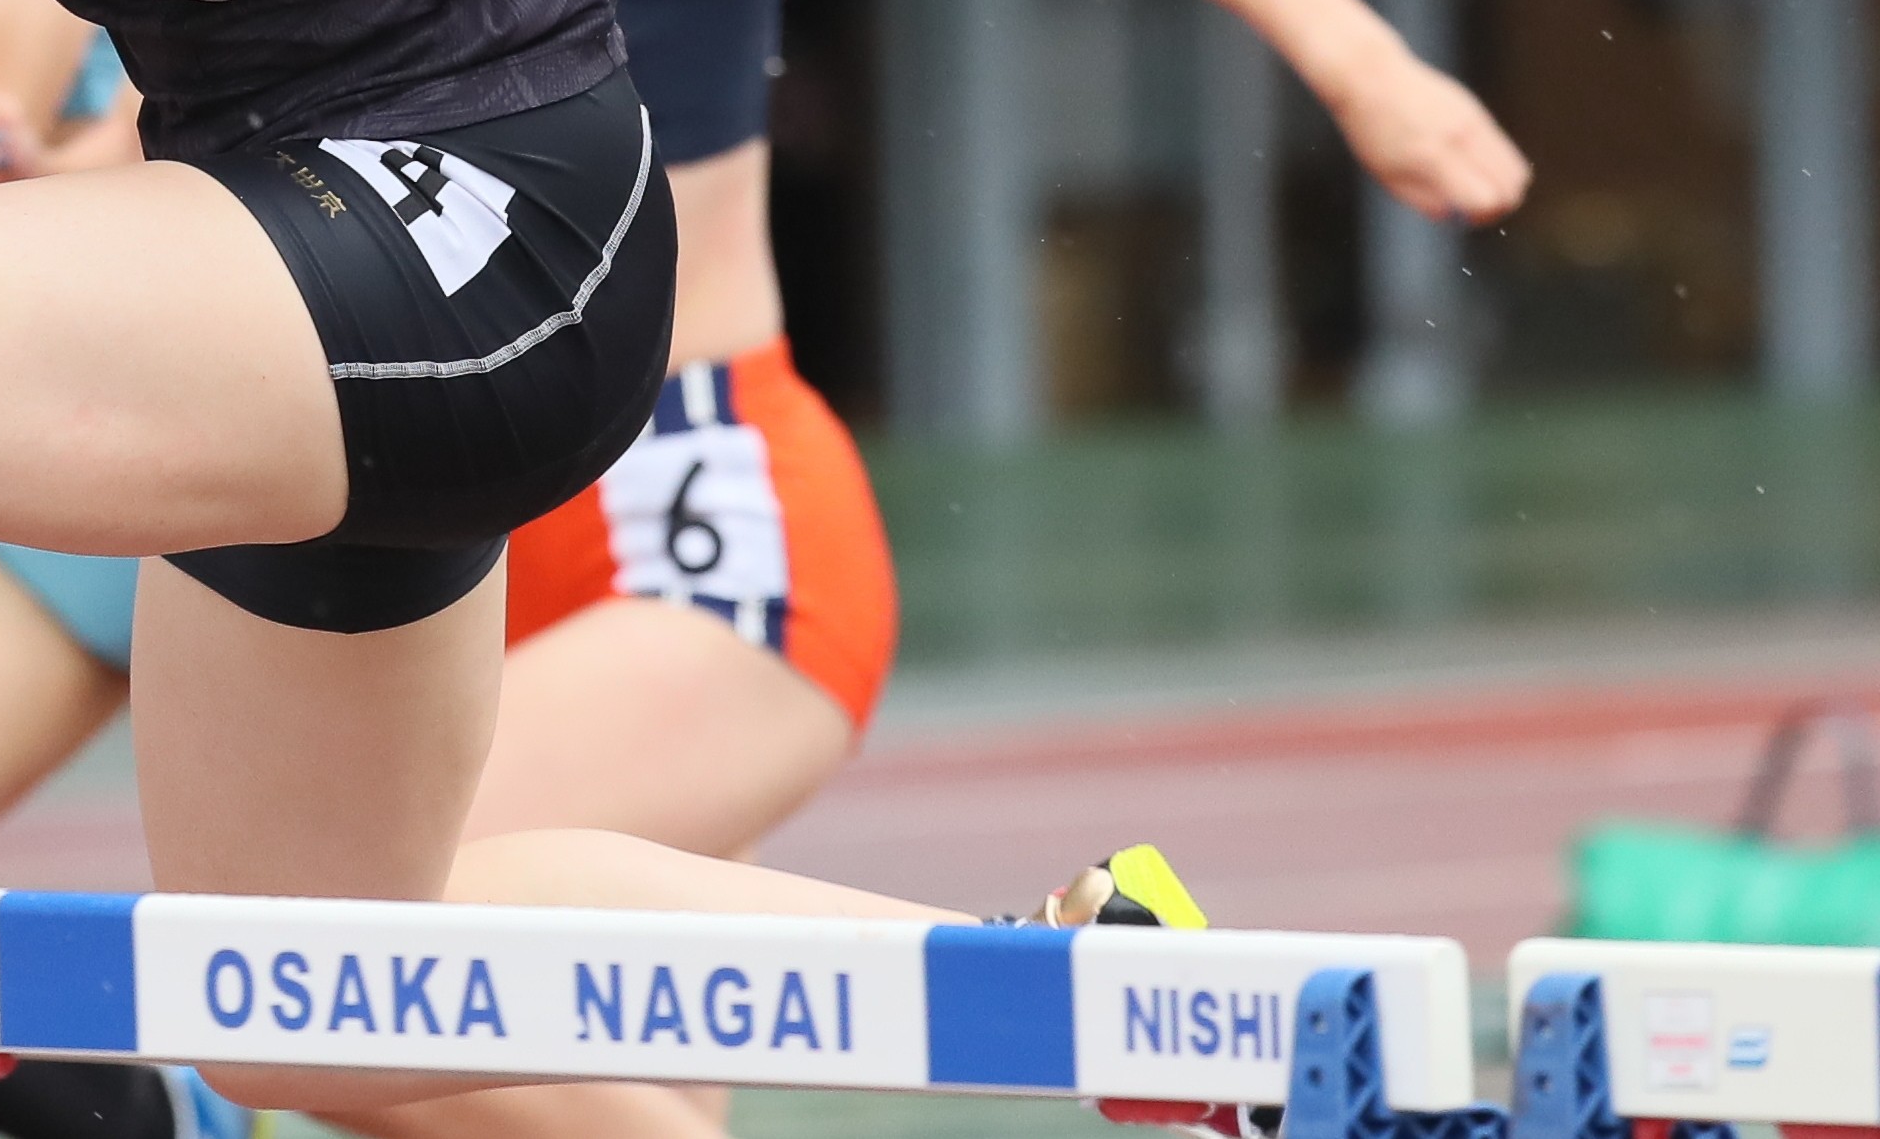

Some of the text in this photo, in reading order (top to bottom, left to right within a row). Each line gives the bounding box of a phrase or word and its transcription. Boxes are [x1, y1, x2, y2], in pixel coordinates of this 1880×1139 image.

[380, 145, 451, 226] 4
[666, 461, 722, 574] 6
[205, 948, 853, 1052] OSAKA NAGAI
[1123, 985, 1281, 1061] NISHI
